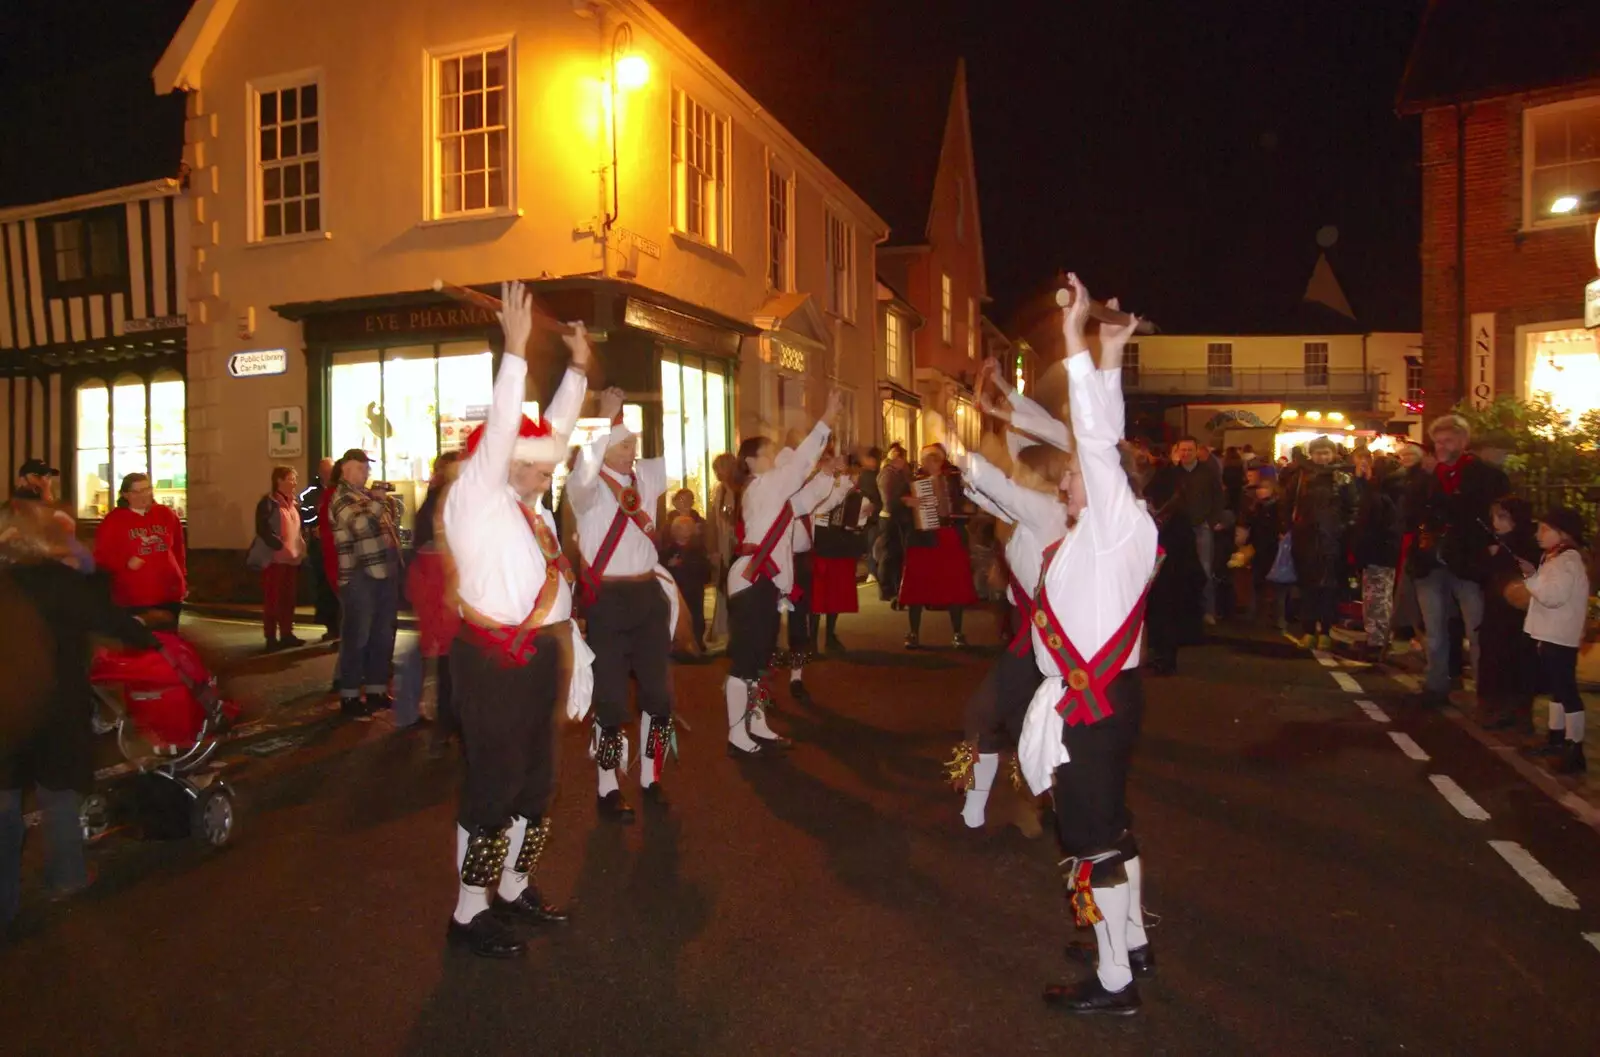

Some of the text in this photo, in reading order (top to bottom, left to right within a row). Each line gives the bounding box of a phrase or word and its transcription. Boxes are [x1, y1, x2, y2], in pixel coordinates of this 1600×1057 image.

[365, 314, 399, 332] EYE
[261, 354, 283, 362] Library
[240, 364, 252, 372] Car
